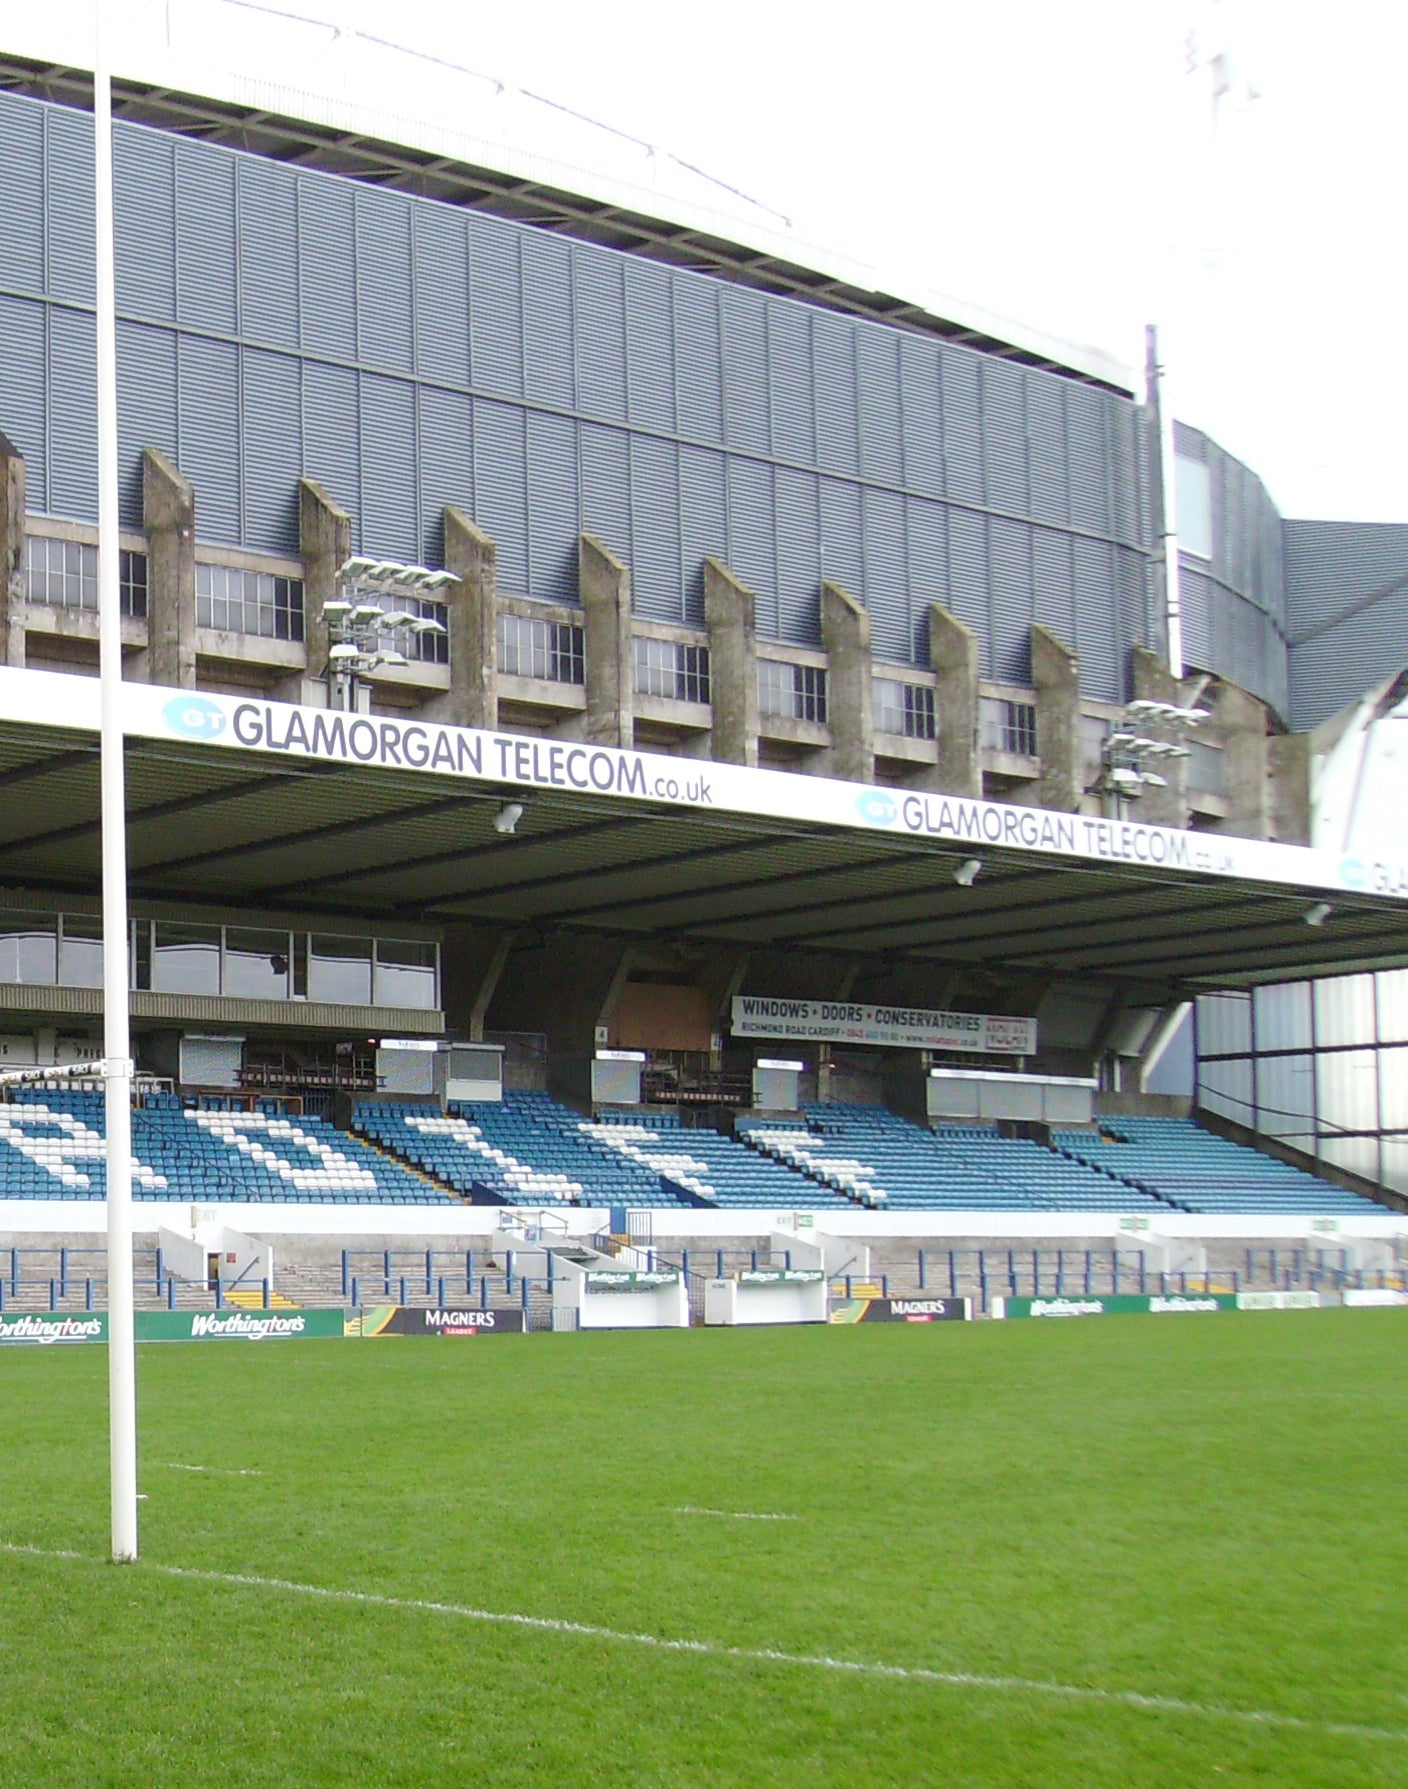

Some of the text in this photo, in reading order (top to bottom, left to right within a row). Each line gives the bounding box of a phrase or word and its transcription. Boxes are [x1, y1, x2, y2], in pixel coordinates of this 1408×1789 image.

[233, 703, 713, 804] GLAMORGAN TELECOM.co.uk
[902, 796, 1076, 853] GLAMORGAN
[741, 1021, 784, 1034] RICHMOND
[785, 1024, 807, 1036] ROAD
[808, 1026, 841, 1038] CARDIFF
[742, 998, 981, 1033] WINDOWS DOORS CONSERVATORIES
[425, 1309, 496, 1327] MAGNERS
[890, 1299, 946, 1315] MAGNERS
[190, 1312, 306, 1340] Worthington's
